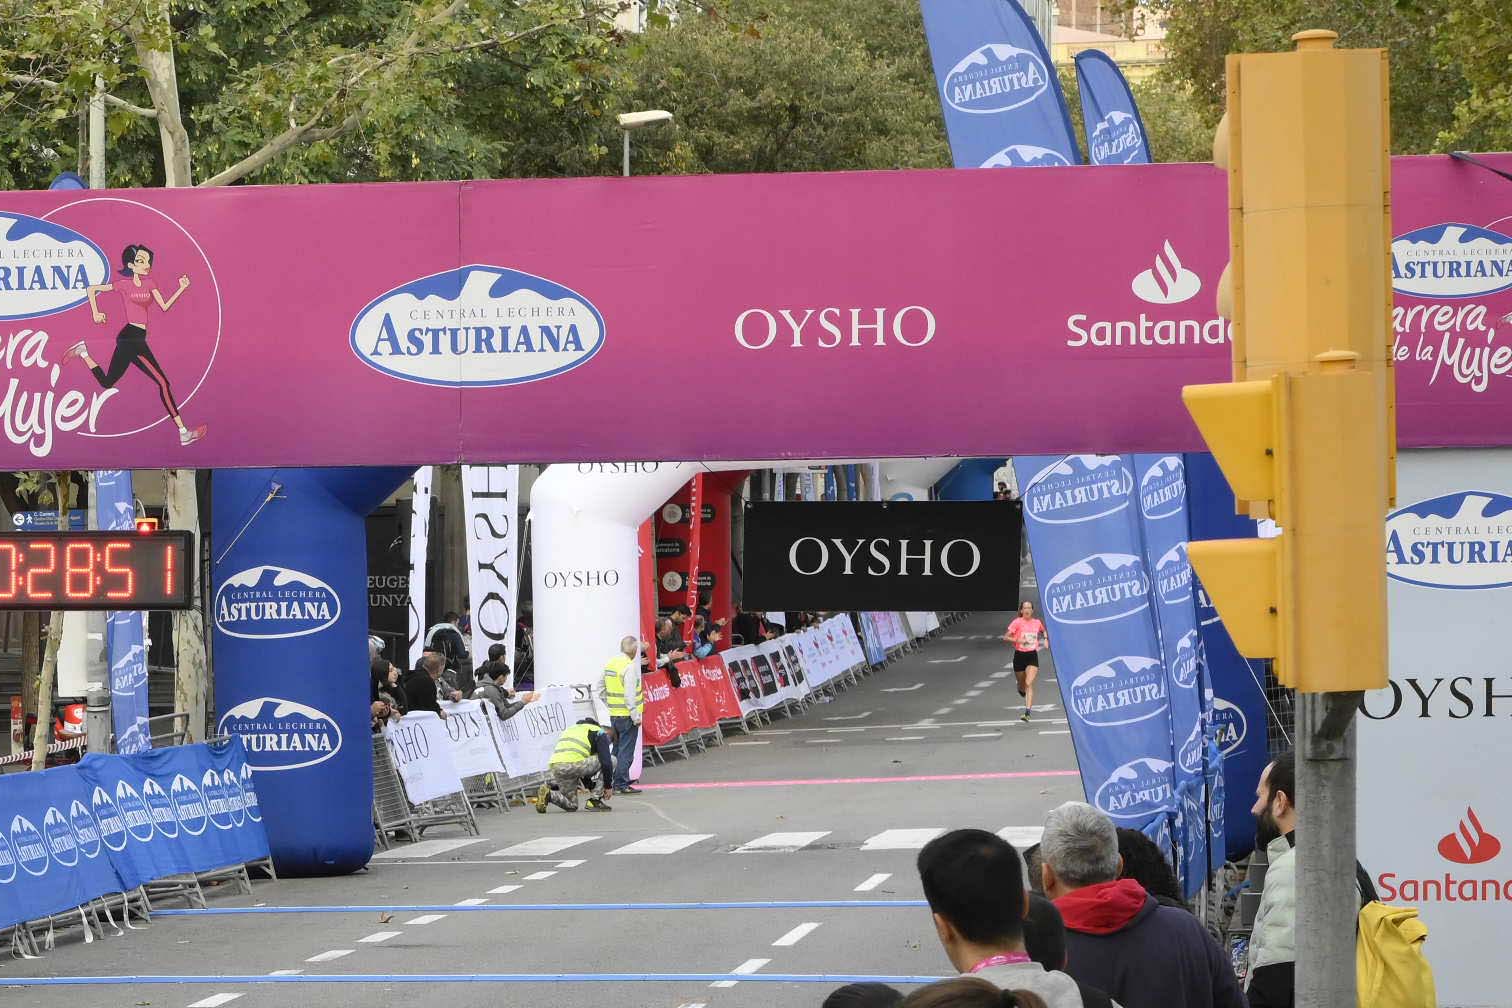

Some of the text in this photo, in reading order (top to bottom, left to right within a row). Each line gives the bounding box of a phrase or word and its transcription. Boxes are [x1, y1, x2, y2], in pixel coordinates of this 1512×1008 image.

[14, 247, 84, 259] LECHERA
[1406, 249, 1458, 257] CENTRAL
[409, 306, 576, 320] CENTRAL LECHERA
[734, 305, 936, 349] OYSHO
[1392, 303, 1488, 332] arrera
[369, 312, 585, 357] ASTURIANA
[1066, 313, 1233, 347] Santand
[1415, 333, 1434, 361] la
[1429, 328, 1512, 392] Muje
[1413, 525, 1481, 536] CENTRAL
[788, 536, 981, 578] OYSHO
[543, 569, 619, 589] OYSHO
[219, 595, 332, 623] ASTURIANA
[231, 590, 327, 600] CENTRAL LECHERA
[1358, 676, 1512, 720] OYSH
[232, 721, 327, 731] CENTRAL LECHERA
[446, 713, 481, 742] OYS
[525, 702, 567, 738] OYSHO
[223, 725, 332, 752] TURIANA
